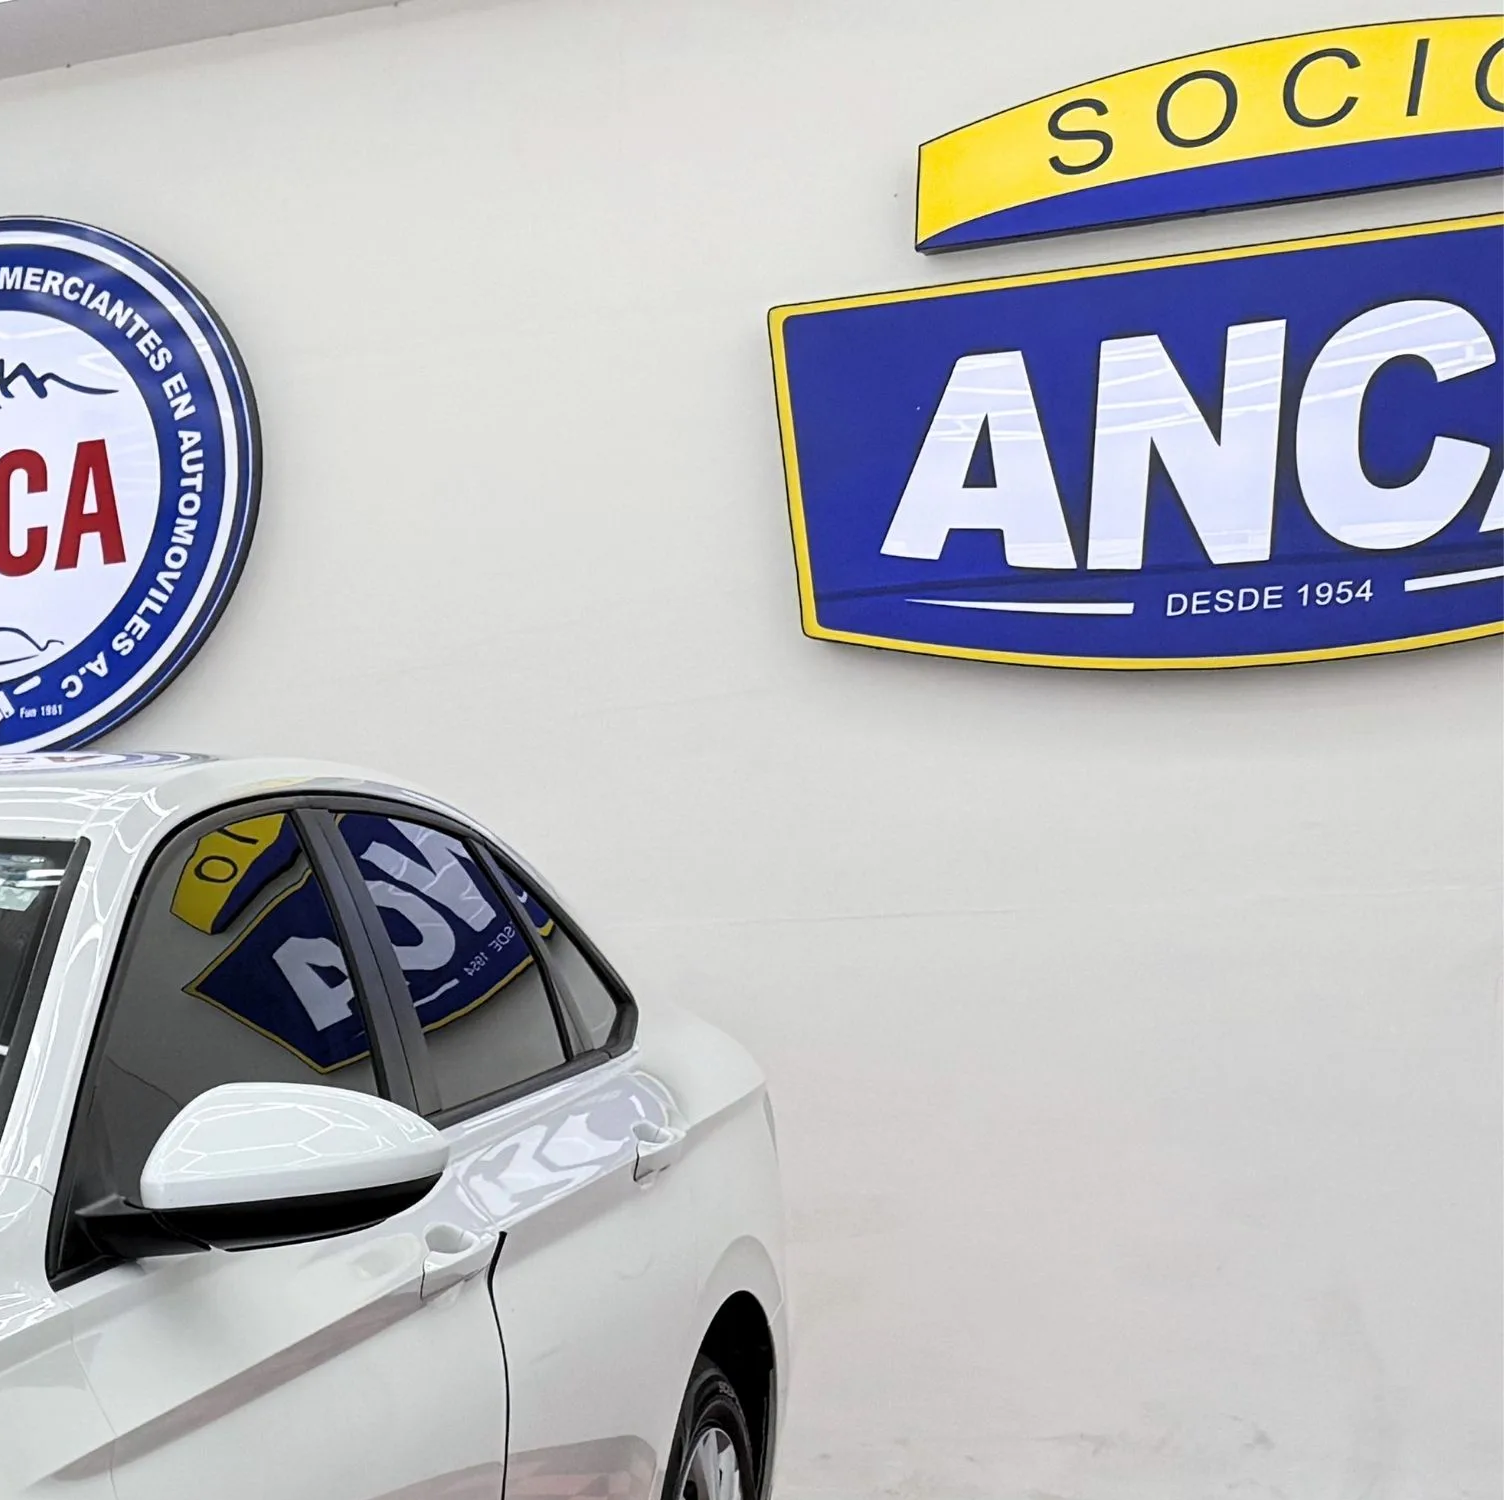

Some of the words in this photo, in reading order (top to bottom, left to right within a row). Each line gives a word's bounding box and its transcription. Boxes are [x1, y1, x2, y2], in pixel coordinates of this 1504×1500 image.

[161, 371, 196, 421] EN
[881, 299, 1504, 570] ANC
[111, 430, 205, 656] AUTOMOVILES
[1166, 585, 1284, 617] DESDE
[1297, 579, 1374, 606] 1954
